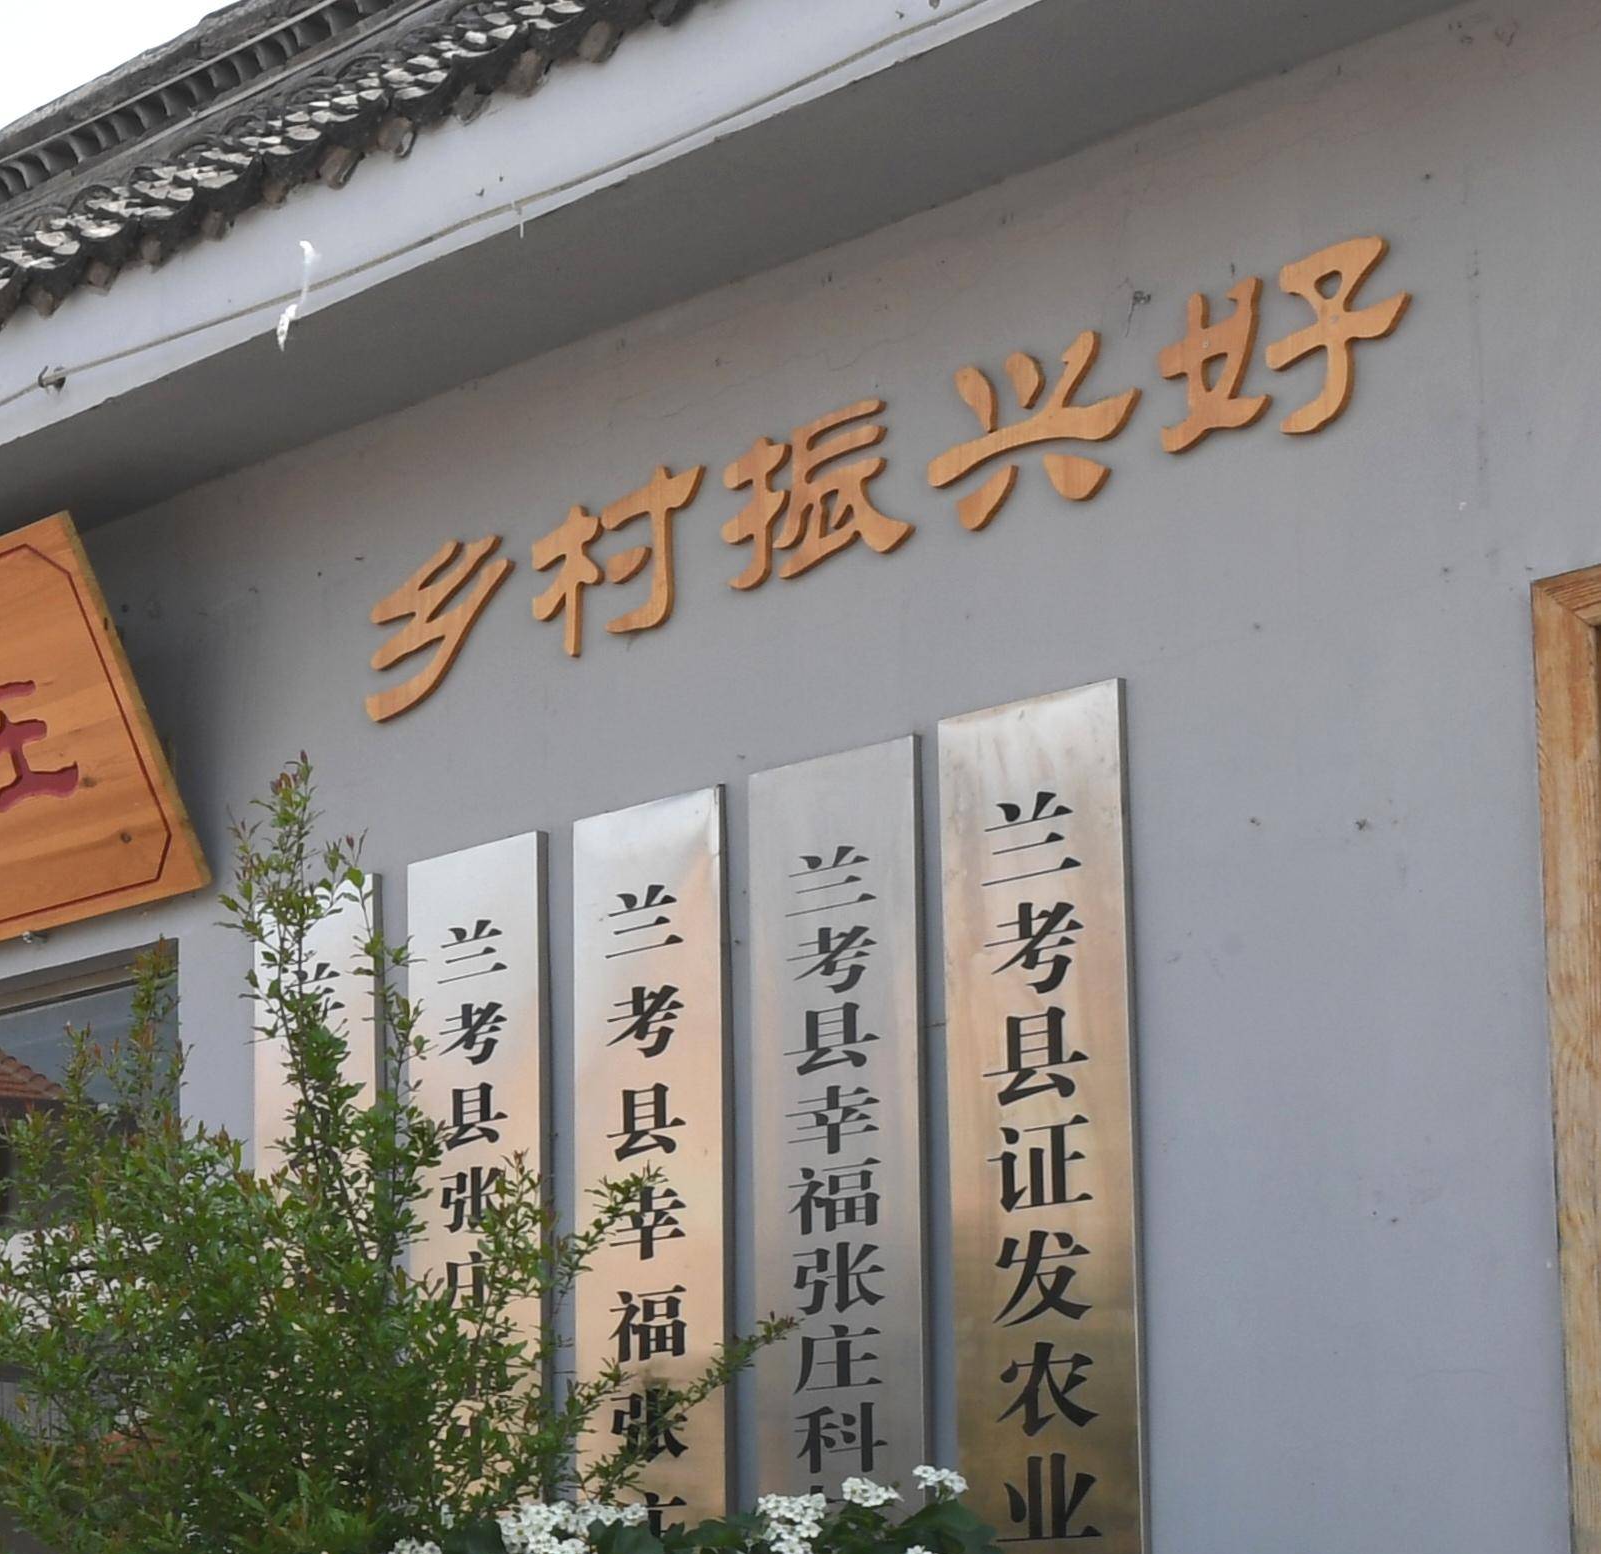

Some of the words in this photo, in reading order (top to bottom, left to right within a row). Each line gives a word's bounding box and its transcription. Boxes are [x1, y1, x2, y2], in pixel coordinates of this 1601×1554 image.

[365, 235, 1412, 723] 乡村振兴好
[784, 845, 889, 1503] 兰考县幸福张庄科
